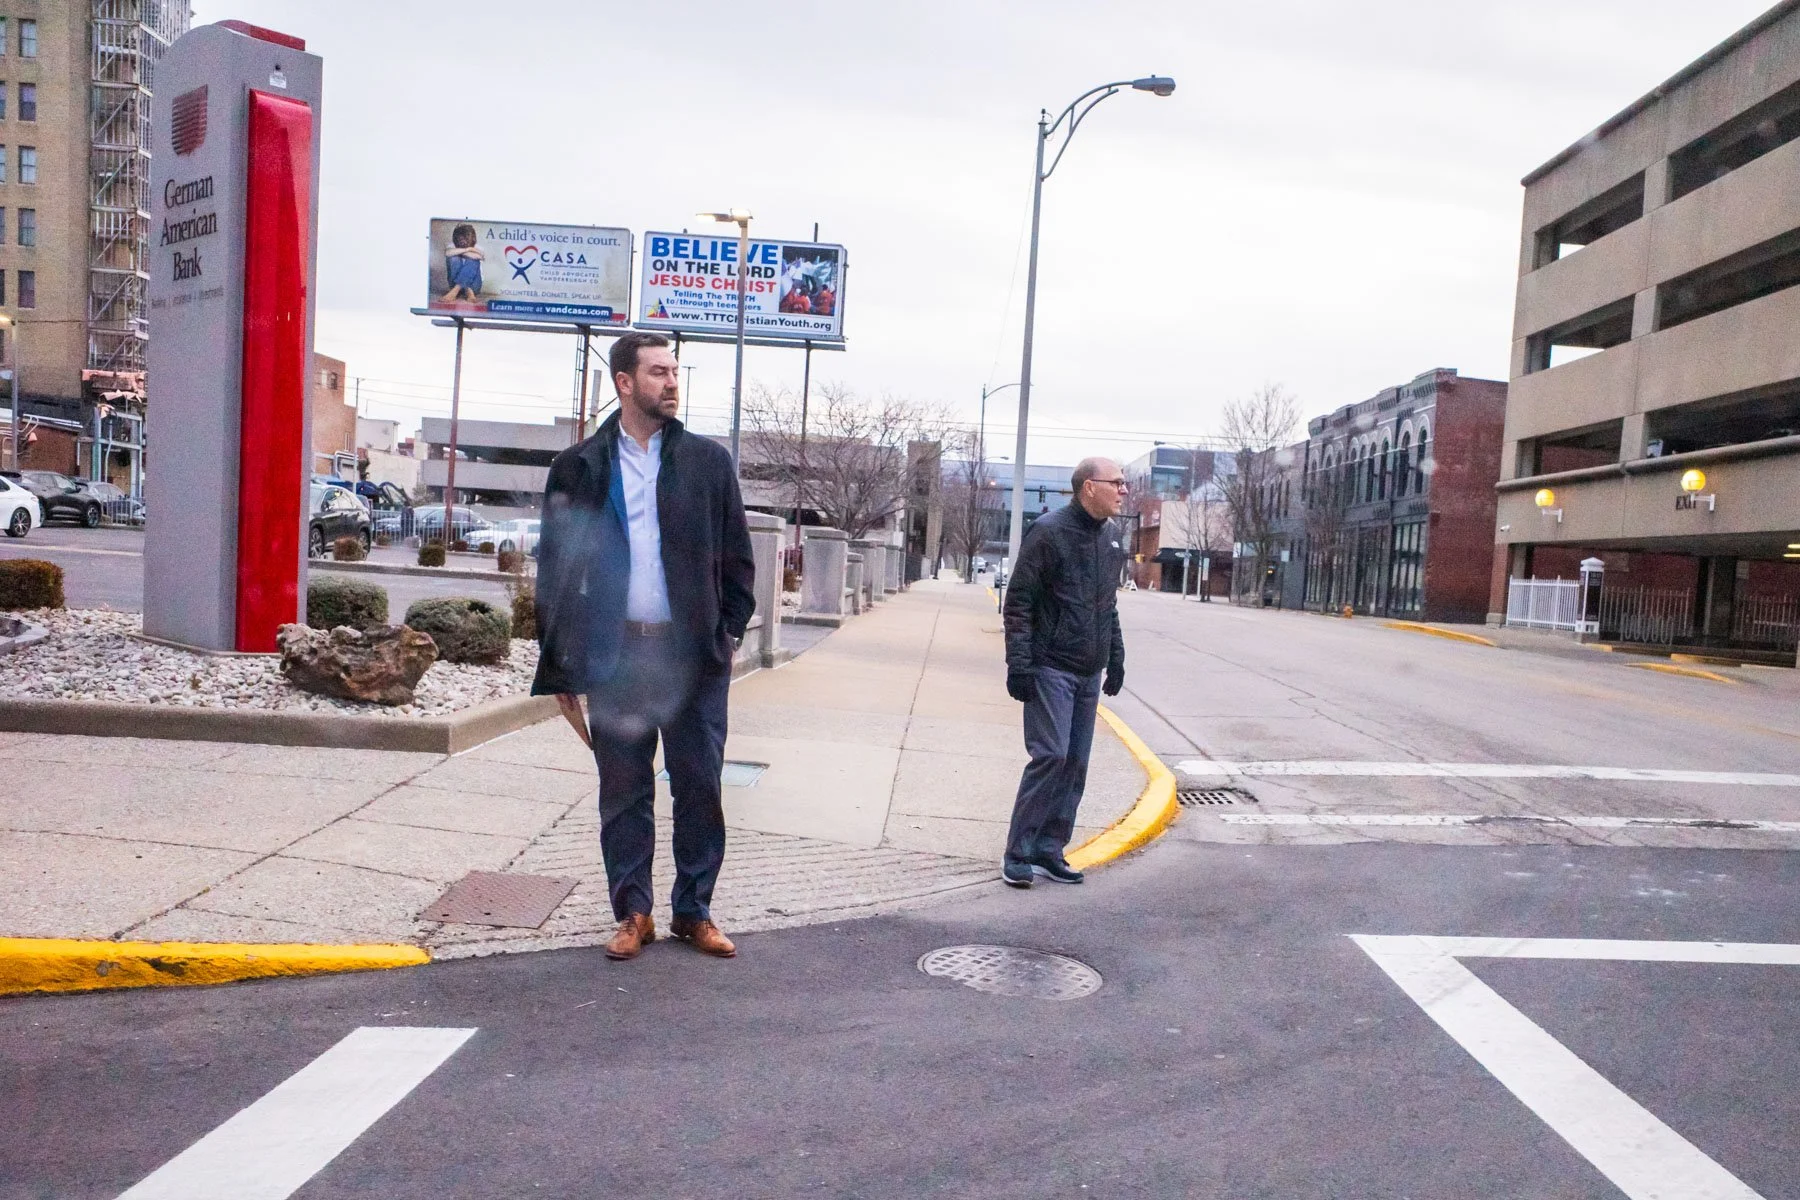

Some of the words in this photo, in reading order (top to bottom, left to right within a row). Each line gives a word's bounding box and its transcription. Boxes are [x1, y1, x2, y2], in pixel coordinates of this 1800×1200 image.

[164, 175, 213, 209] German
[160, 208, 217, 246] American
[486, 228, 495, 239] A
[499, 228, 536, 241] child's
[540, 233, 568, 243] voice
[572, 233, 583, 244] in
[587, 236, 621, 246] court.
[540, 251, 587, 265] CASA
[651, 237, 778, 265] BELIEVE
[173, 247, 202, 281] Bank
[652, 259, 678, 272] ON
[685, 261, 720, 275] THE
[649, 274, 706, 289] JESUS
[666, 297, 714, 308] to/through
[717, 301, 762, 311] teeners
[673, 289, 703, 299] Telling
[706, 292, 723, 300] The
[725, 293, 756, 303] TRTH
[491, 302, 512, 311] Learn
[545, 305, 610, 316] vandcasa.com
